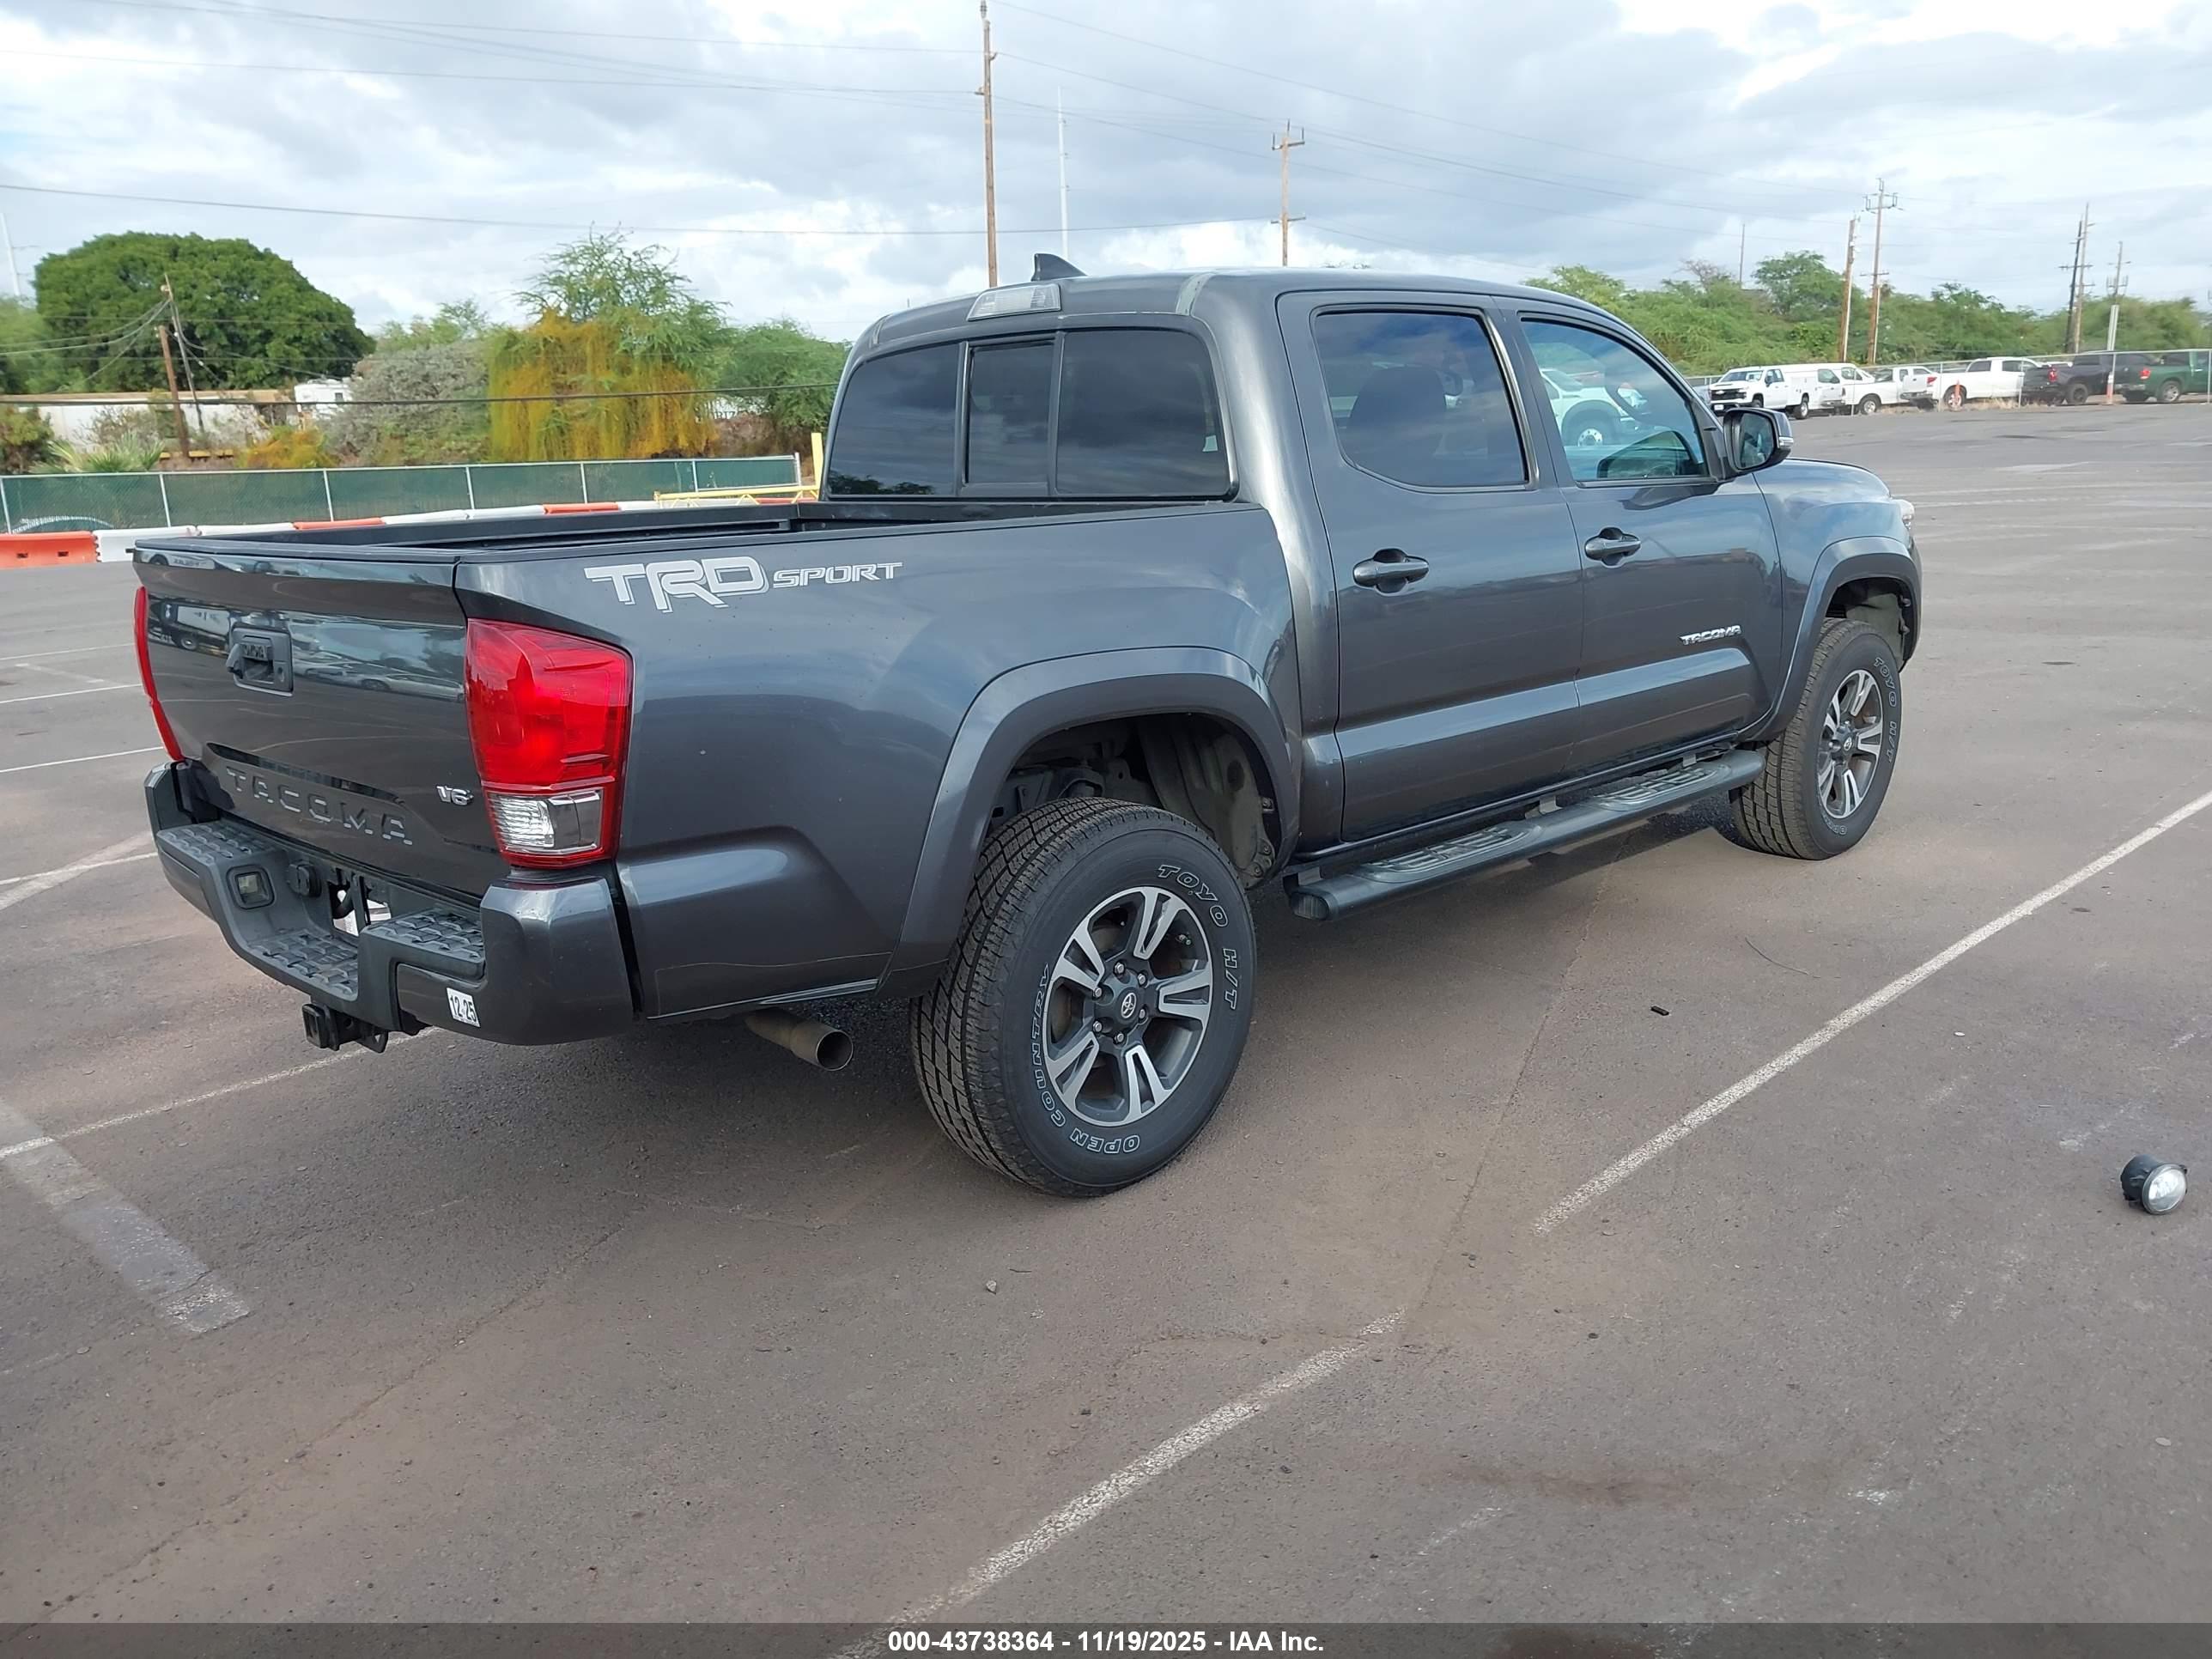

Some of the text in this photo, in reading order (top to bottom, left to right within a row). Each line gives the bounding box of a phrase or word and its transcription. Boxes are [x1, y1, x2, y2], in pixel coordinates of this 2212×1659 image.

[584, 556, 903, 613] TRD SPORT
[1680, 624, 1741, 646] TACOMA
[1872, 657, 1897, 708] TOYO
[226, 766, 413, 846] TACOMA
[436, 785, 469, 805] V6
[1158, 864, 1238, 1010] TOYO H/T
[1031, 962, 1140, 1154] OPEN COUNTRY
